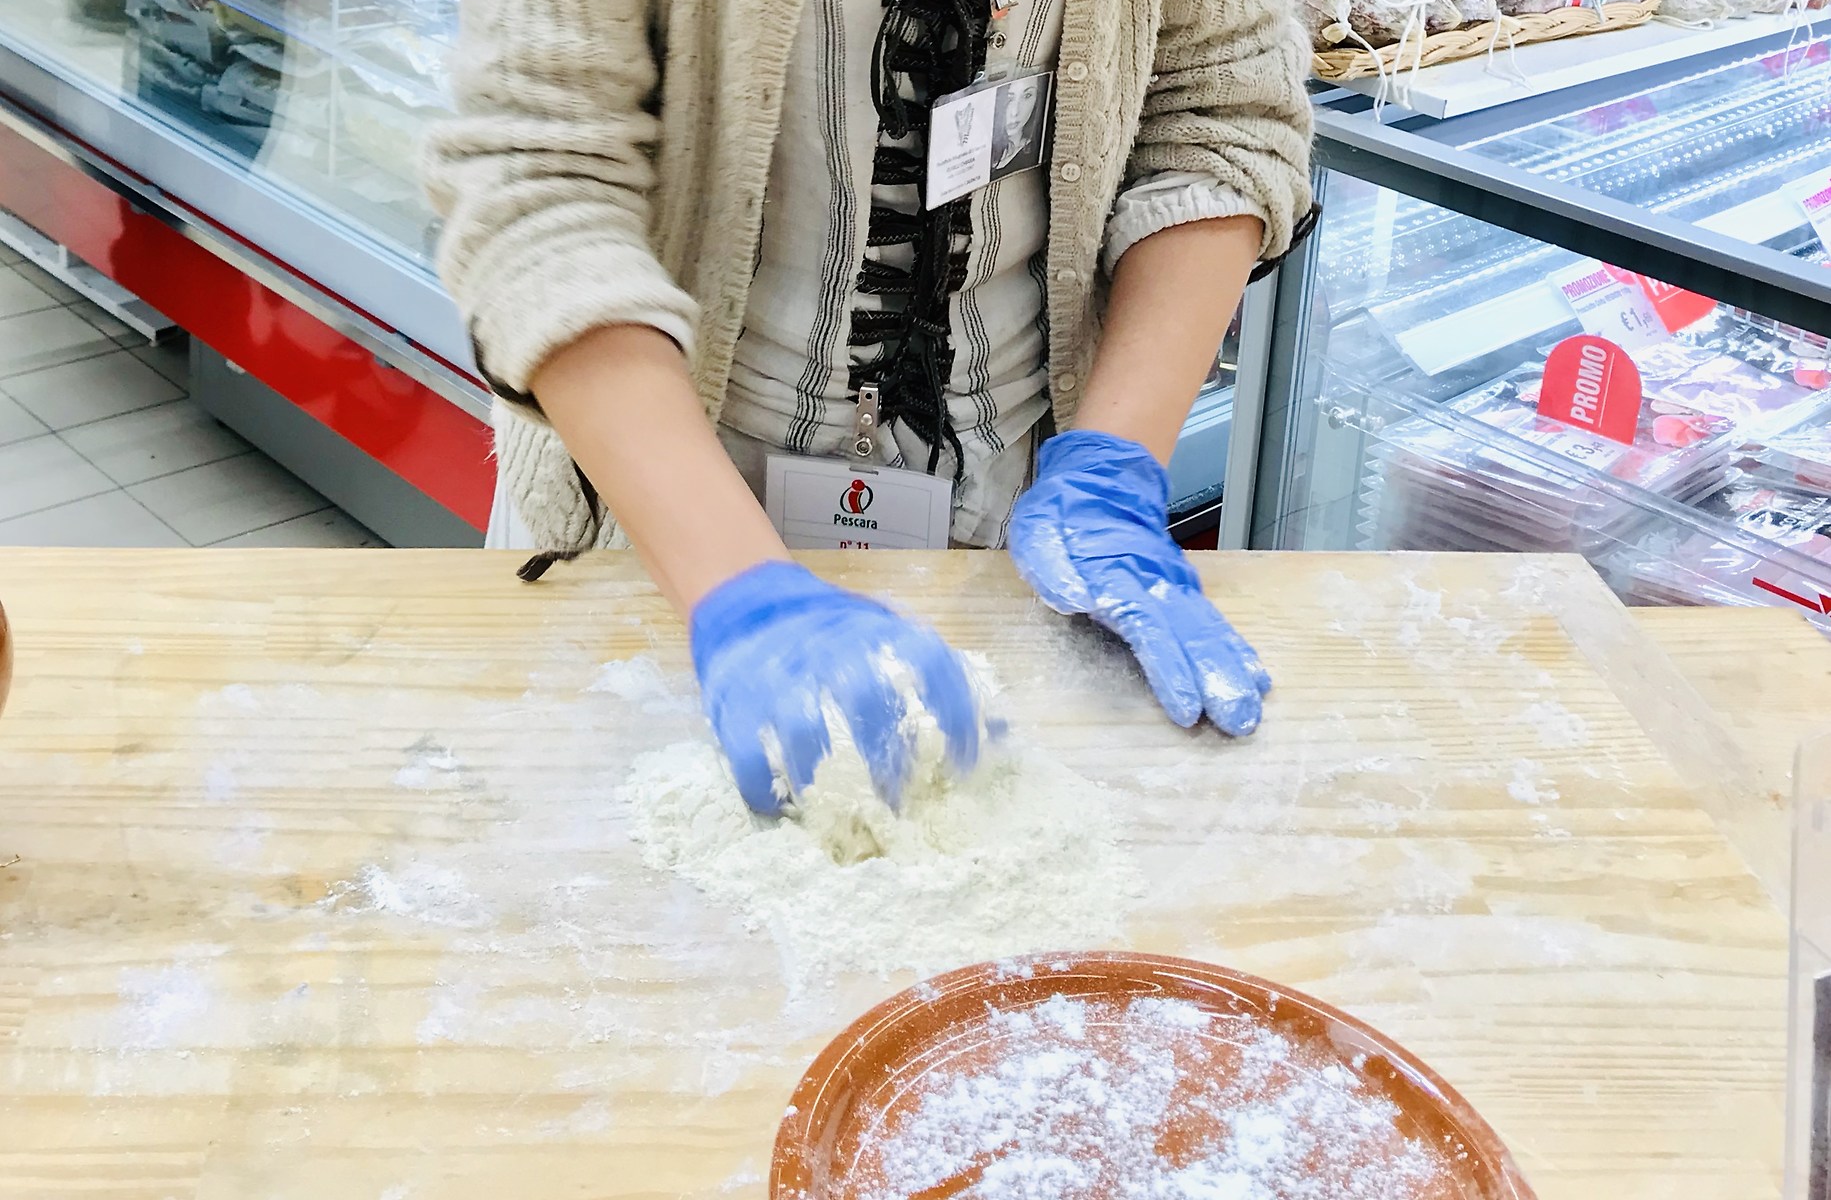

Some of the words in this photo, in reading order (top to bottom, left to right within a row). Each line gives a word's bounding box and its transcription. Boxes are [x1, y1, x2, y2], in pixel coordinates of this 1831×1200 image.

[1561, 269, 1611, 300] PROMOZIONE
[1570, 344, 1607, 425] PROMO
[833, 513, 878, 530] Pescara
